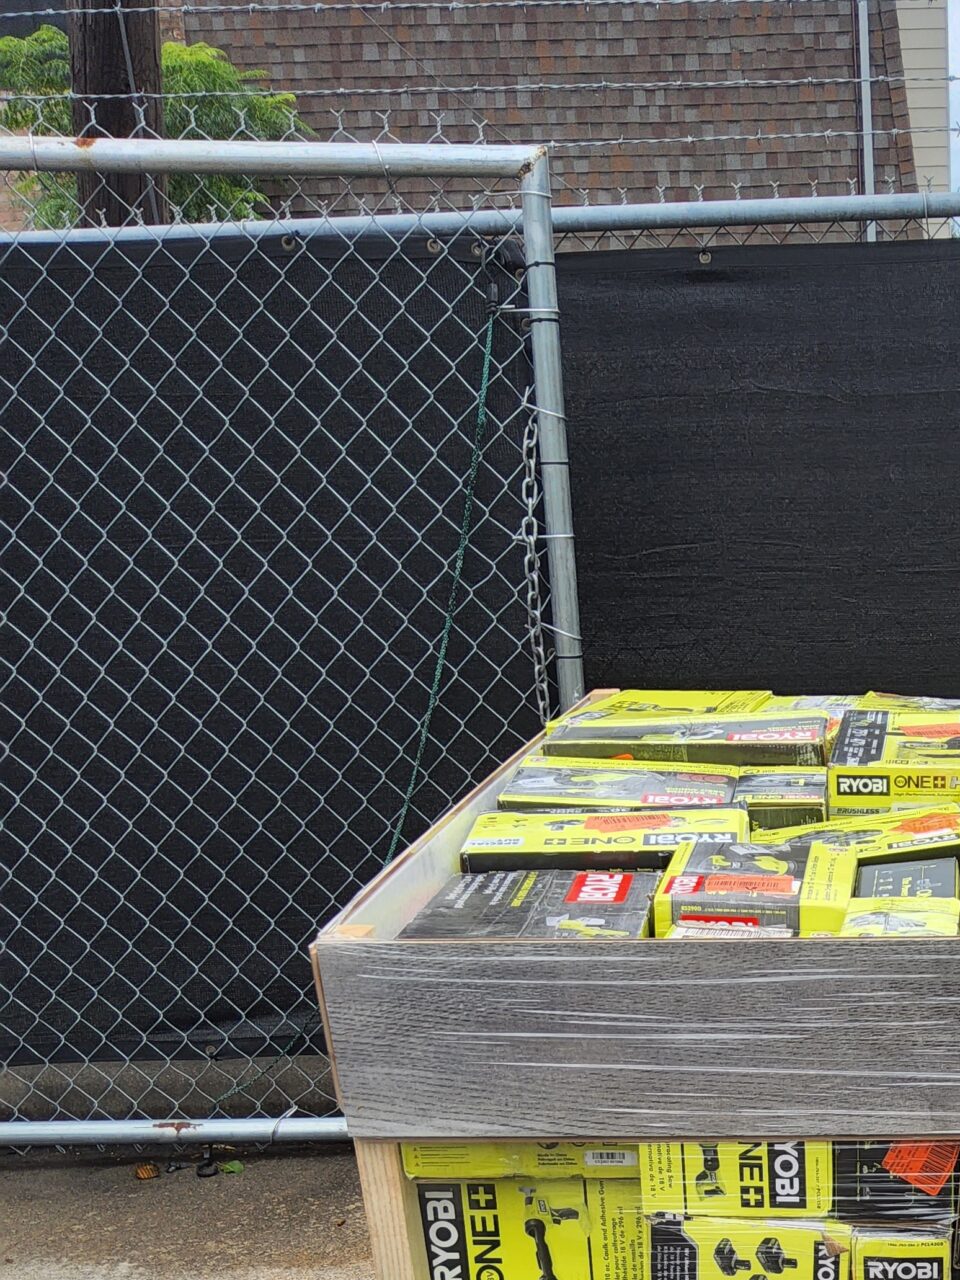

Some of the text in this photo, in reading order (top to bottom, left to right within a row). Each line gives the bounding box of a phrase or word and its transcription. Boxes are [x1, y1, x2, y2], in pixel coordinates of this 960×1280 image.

[839, 778, 888, 793] RYOBI
[895, 776, 946, 788] ONE+
[602, 1243, 610, 1260] Caulk
[612, 1256, 620, 1270] pour
[868, 1262, 938, 1279] RYOBI
